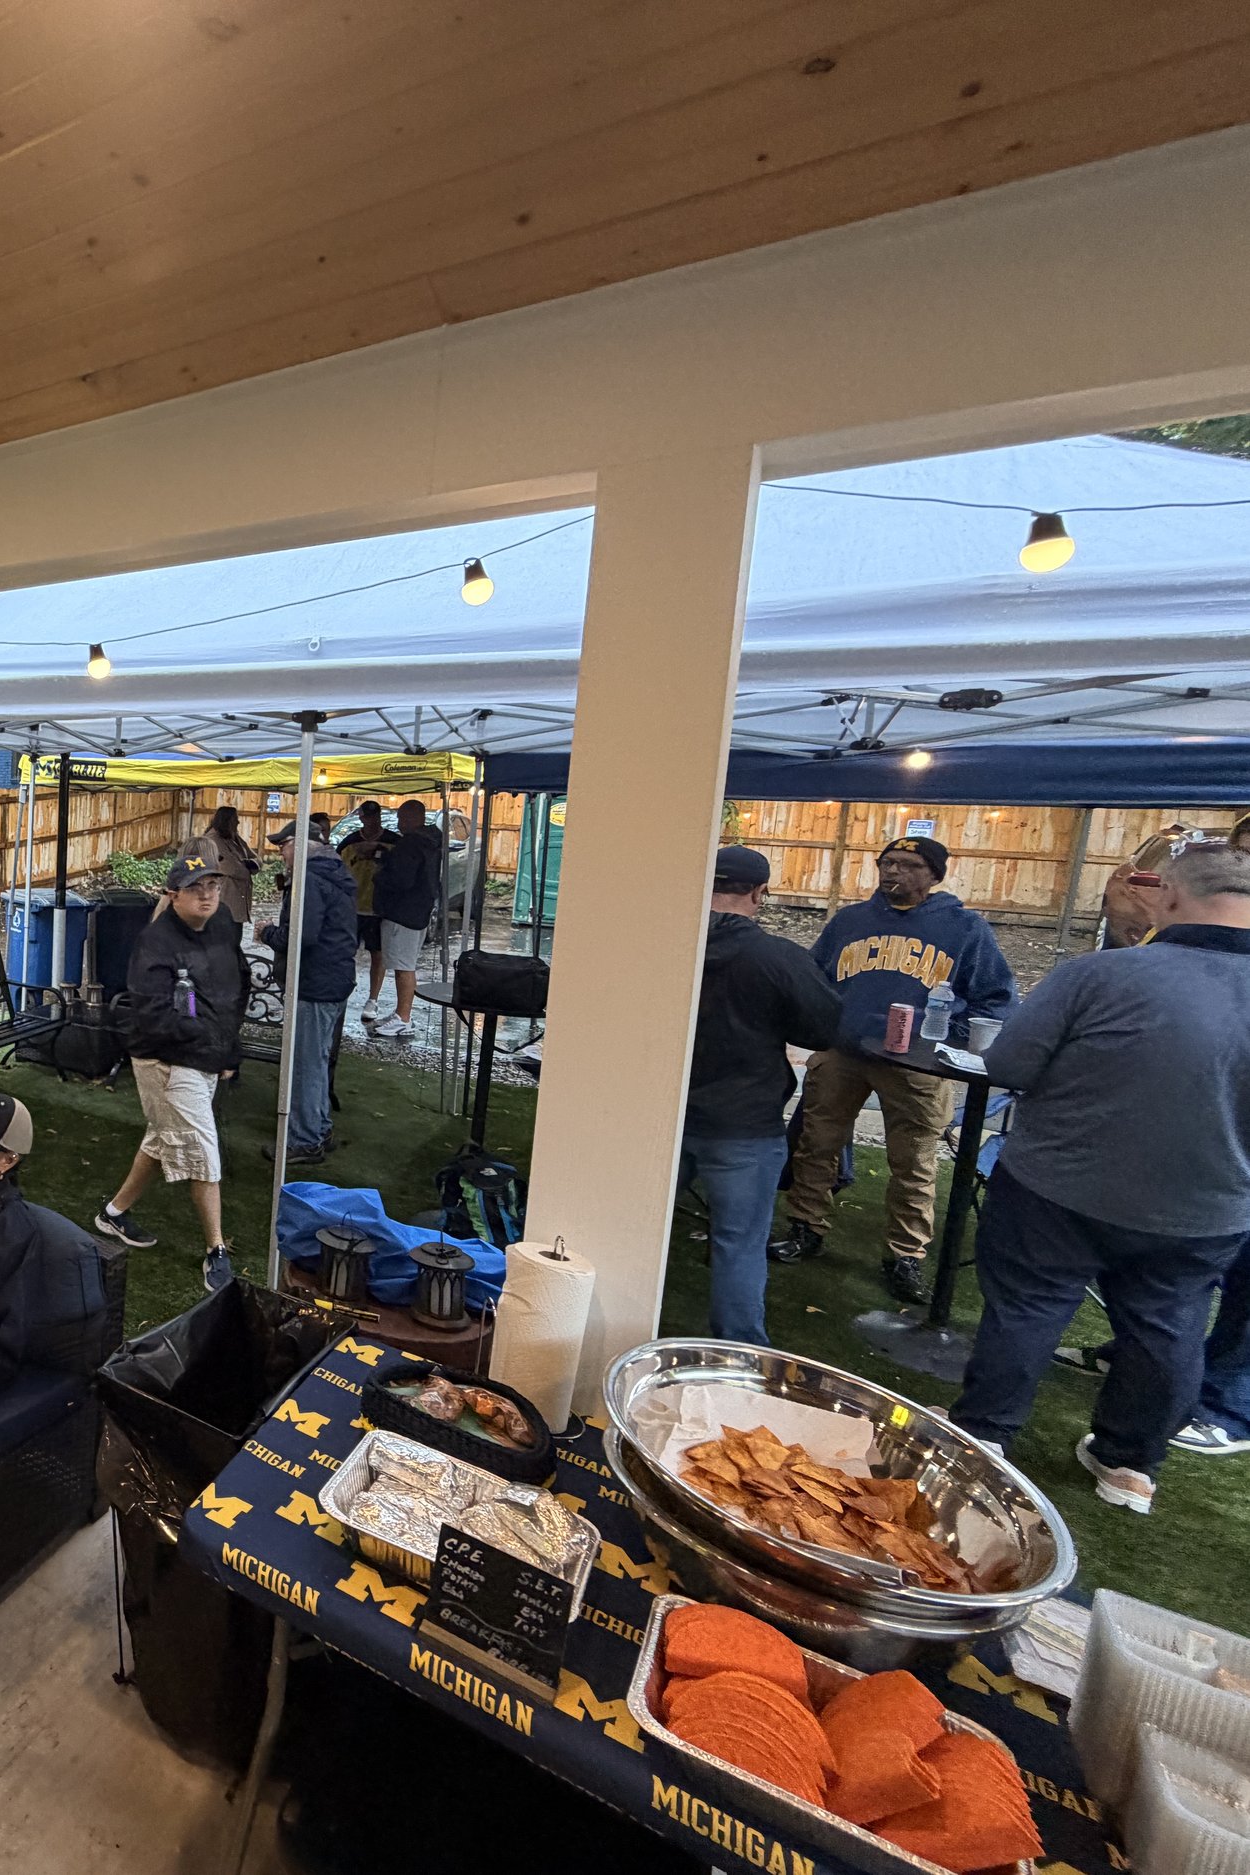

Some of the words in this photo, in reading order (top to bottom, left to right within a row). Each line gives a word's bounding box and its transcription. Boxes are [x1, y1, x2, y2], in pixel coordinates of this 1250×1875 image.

[384, 763, 417, 773] Coleman
[894, 839, 920, 851] M
[185, 857, 206, 871] M
[836, 935, 955, 989] MICHIGAN
[334, 1336, 385, 1367] M
[272, 1398, 331, 1439] M
[242, 1439, 306, 1479] CHIGAN
[439, 1555, 486, 1582] CHORIZO
[444, 1538, 485, 1565] C.P.E.
[222, 1542, 321, 1616] MICHIGAN
[335, 1560, 428, 1628] M
[441, 1567, 480, 1592] POTATO
[517, 1571, 564, 1601] S.E.T.
[409, 1642, 534, 1737] MICHIGAN
[553, 1667, 646, 1754] M
[651, 1774, 815, 1875] MICHIGAN
